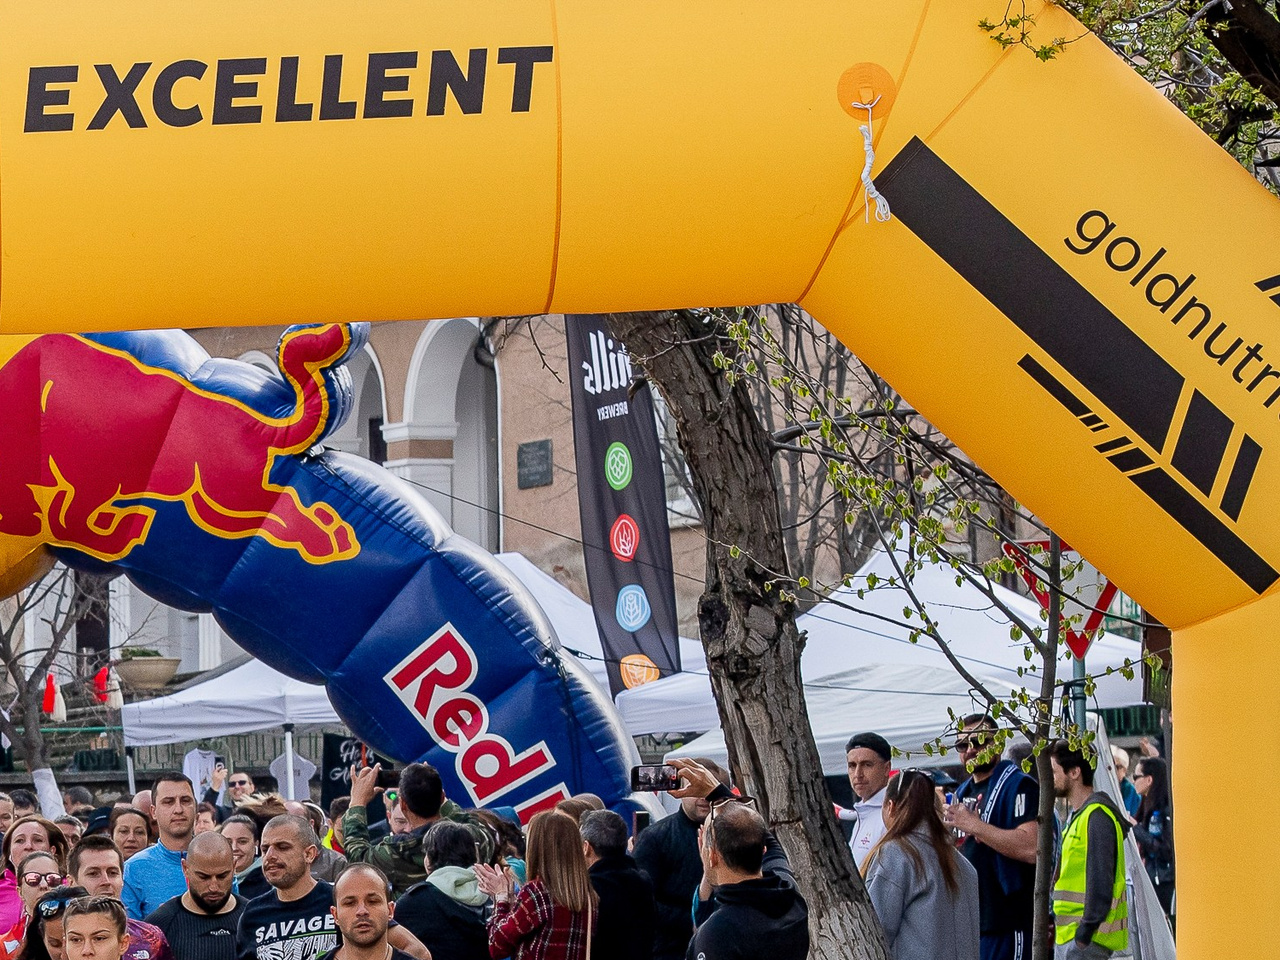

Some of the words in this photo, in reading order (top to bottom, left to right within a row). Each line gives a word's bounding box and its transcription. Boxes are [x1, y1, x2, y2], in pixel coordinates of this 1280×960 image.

[23, 46, 553, 133] EXCELLENT
[384, 623, 555, 807] Red
[255, 914, 336, 943] SAVAGE
